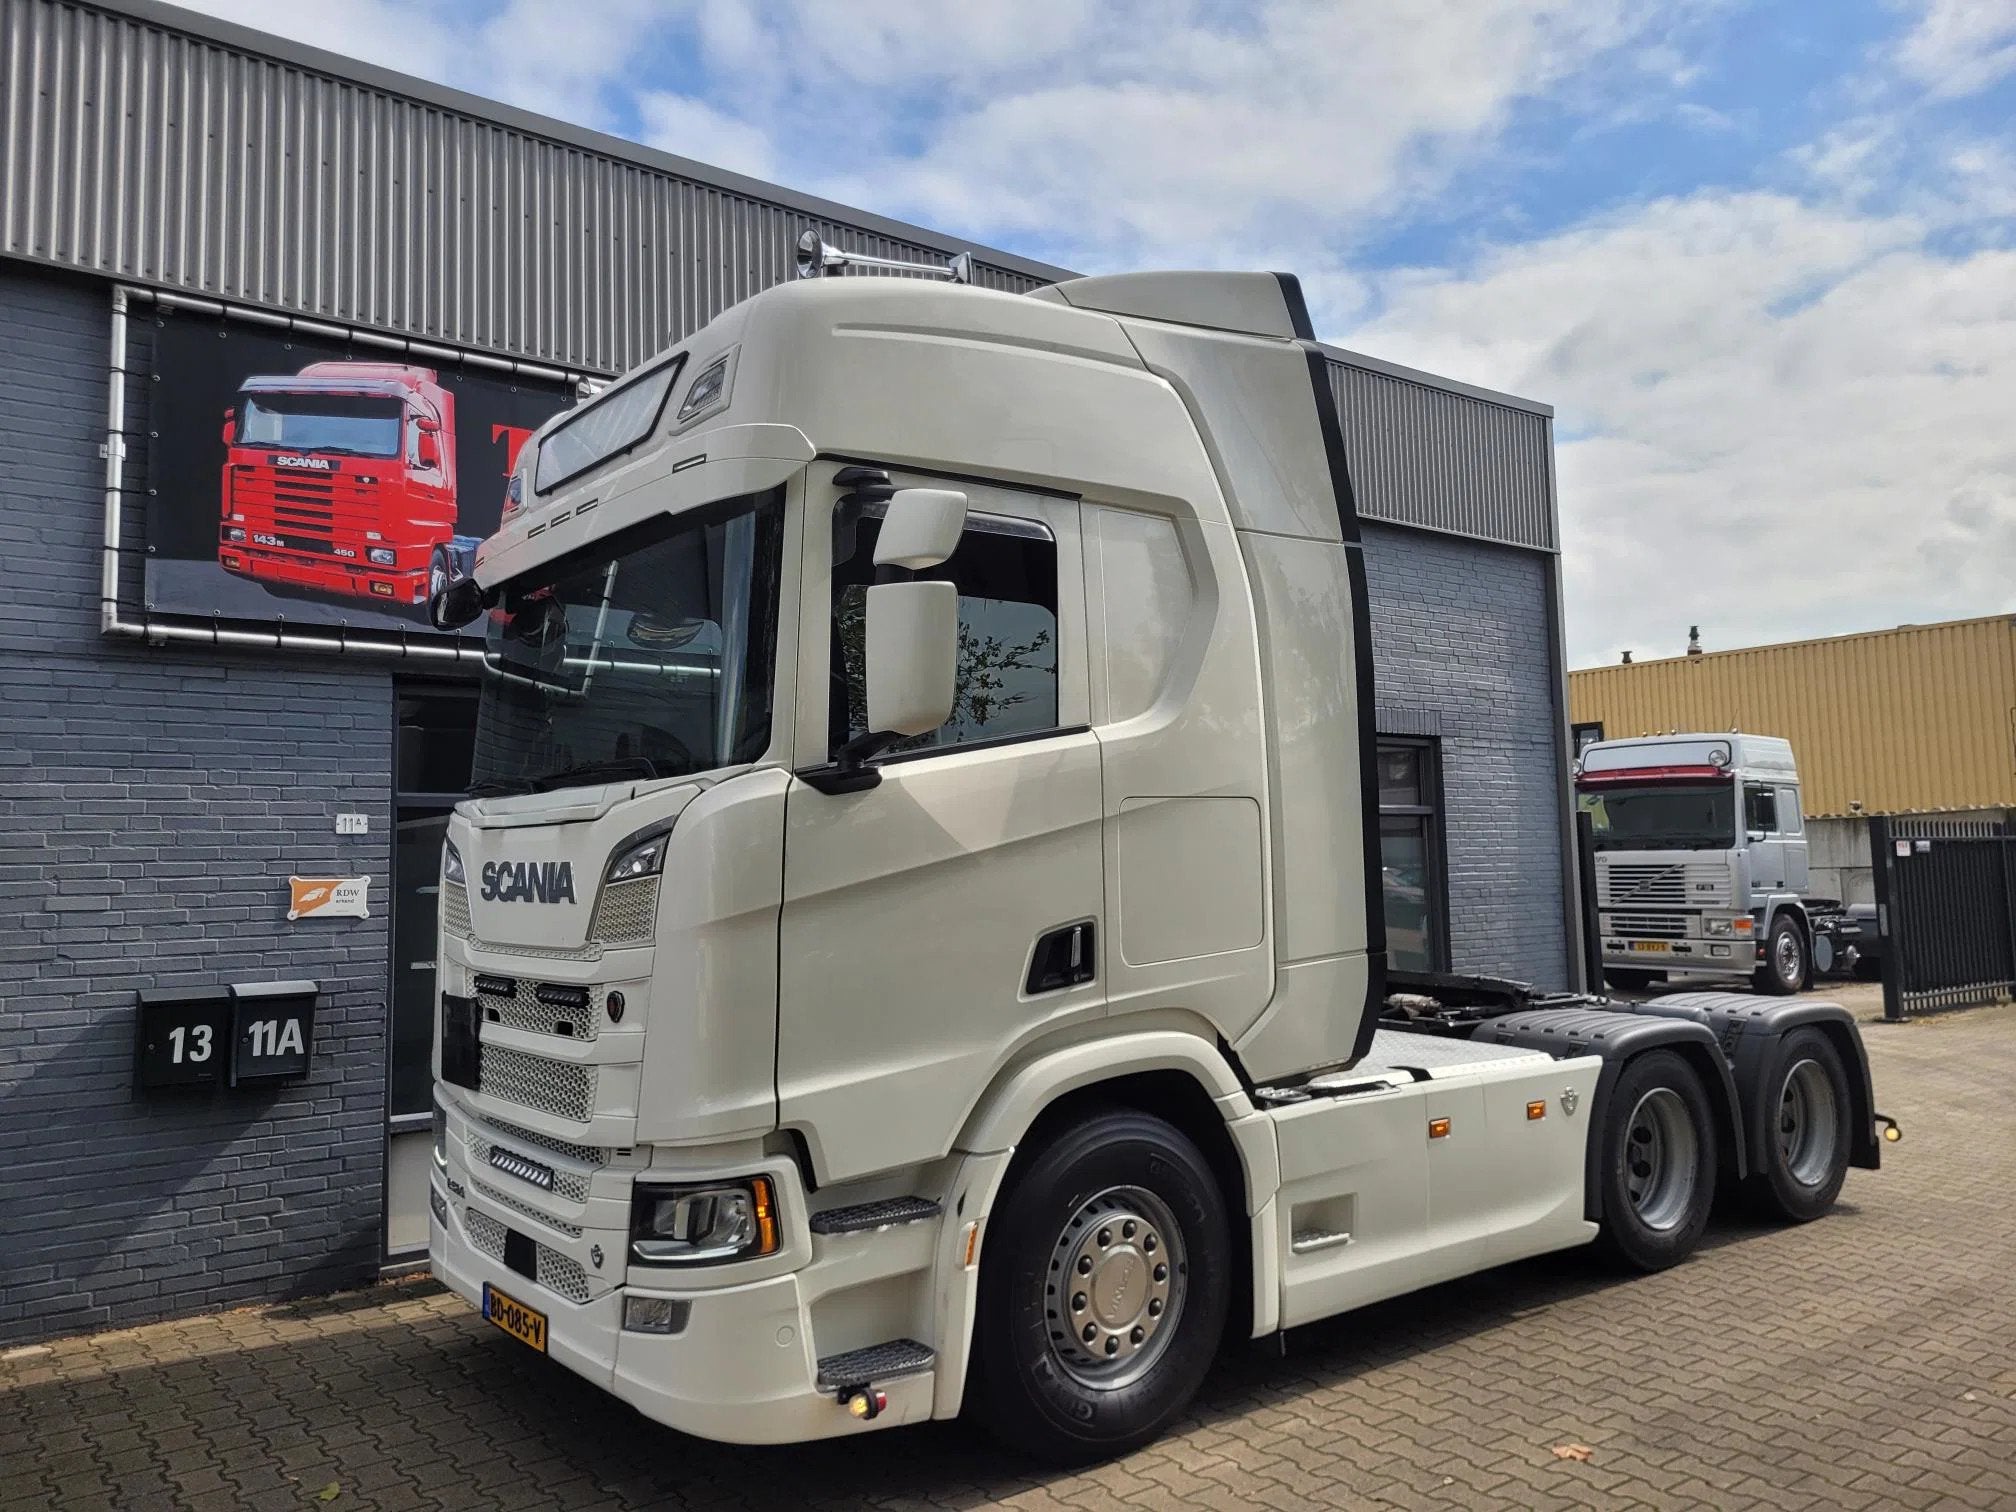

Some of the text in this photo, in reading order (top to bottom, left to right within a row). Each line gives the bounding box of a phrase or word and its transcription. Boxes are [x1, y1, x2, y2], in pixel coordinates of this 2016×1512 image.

[277, 456, 330, 470] SCANIA
[333, 548, 355, 557] 450
[343, 817, 362, 833] 11A
[336, 889, 360, 897] RDW
[481, 860, 578, 905] SCANIA
[168, 1024, 213, 1064] 13
[248, 1018, 305, 1057] 11A
[489, 1292, 542, 1344] BD-085-V
